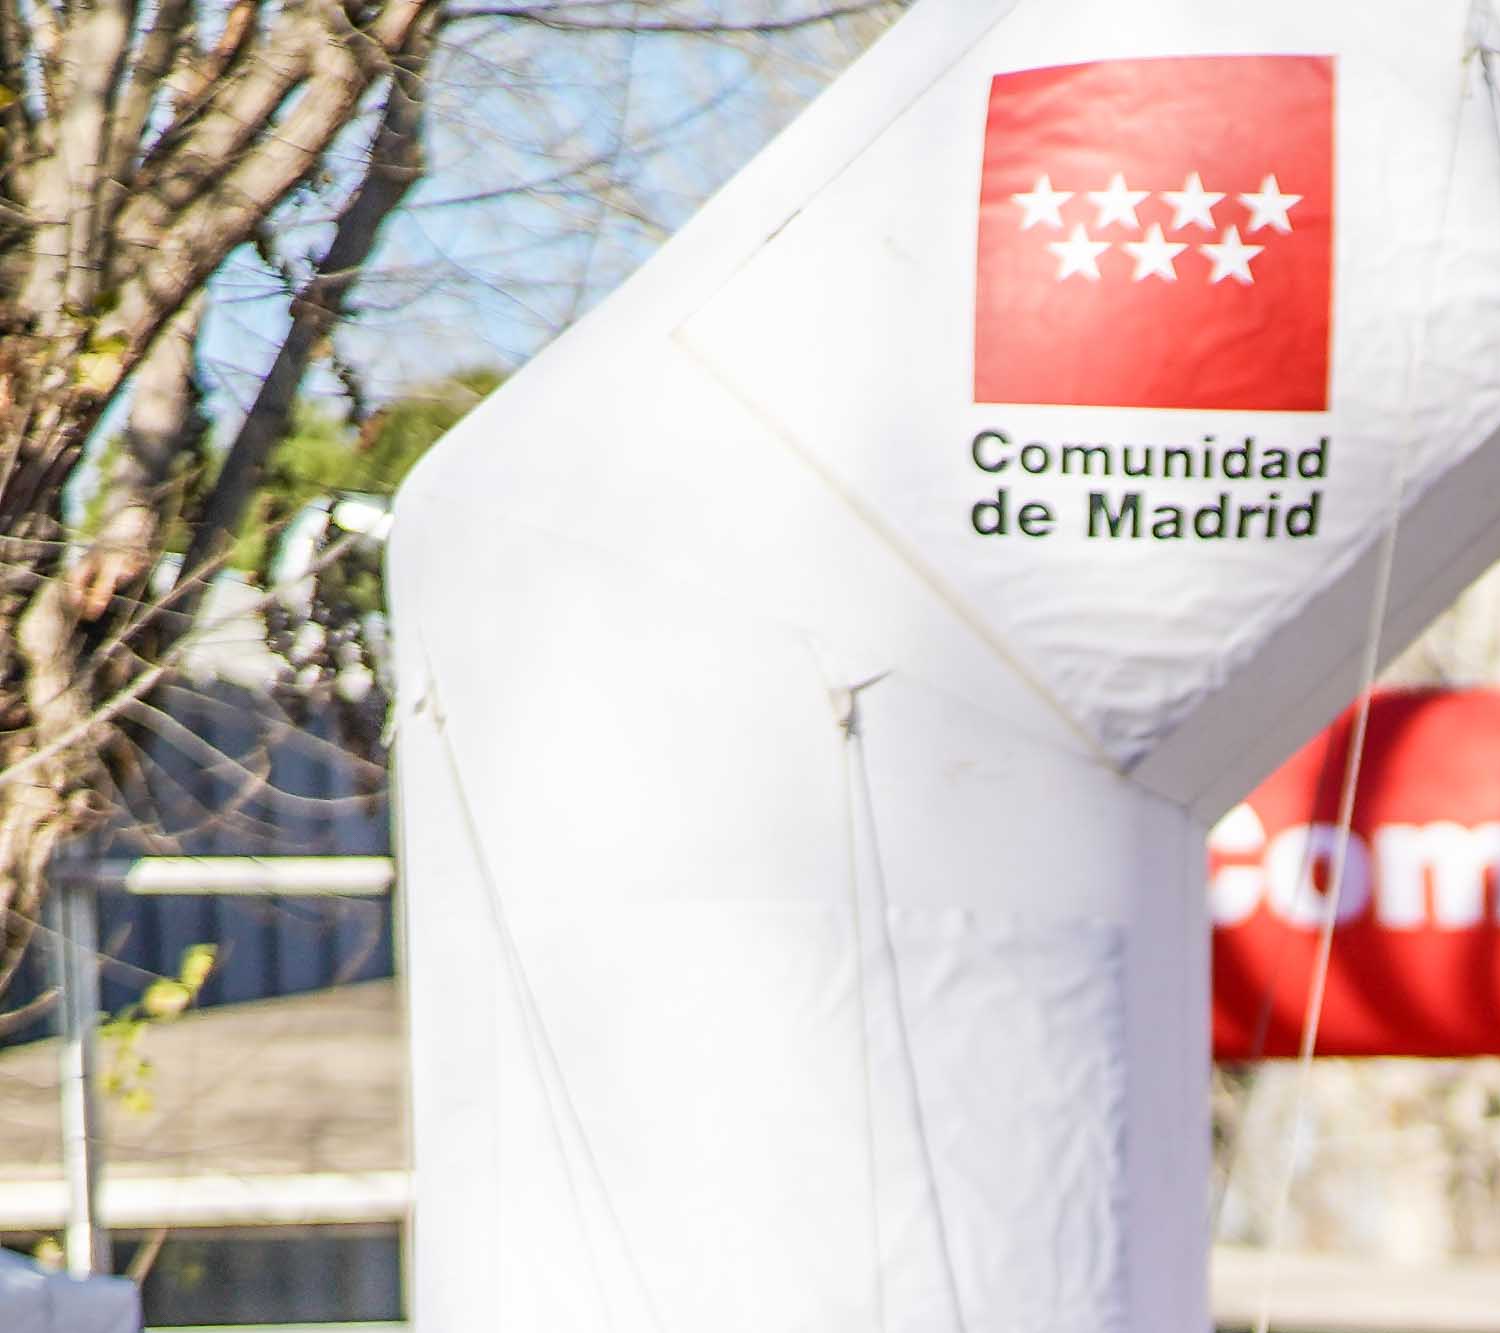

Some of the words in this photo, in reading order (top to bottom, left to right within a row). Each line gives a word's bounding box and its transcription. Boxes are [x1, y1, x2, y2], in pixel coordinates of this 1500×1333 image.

[971, 430, 1329, 480] Comunidad
[971, 488, 1056, 537] de
[1088, 493, 1323, 539] Madrid
